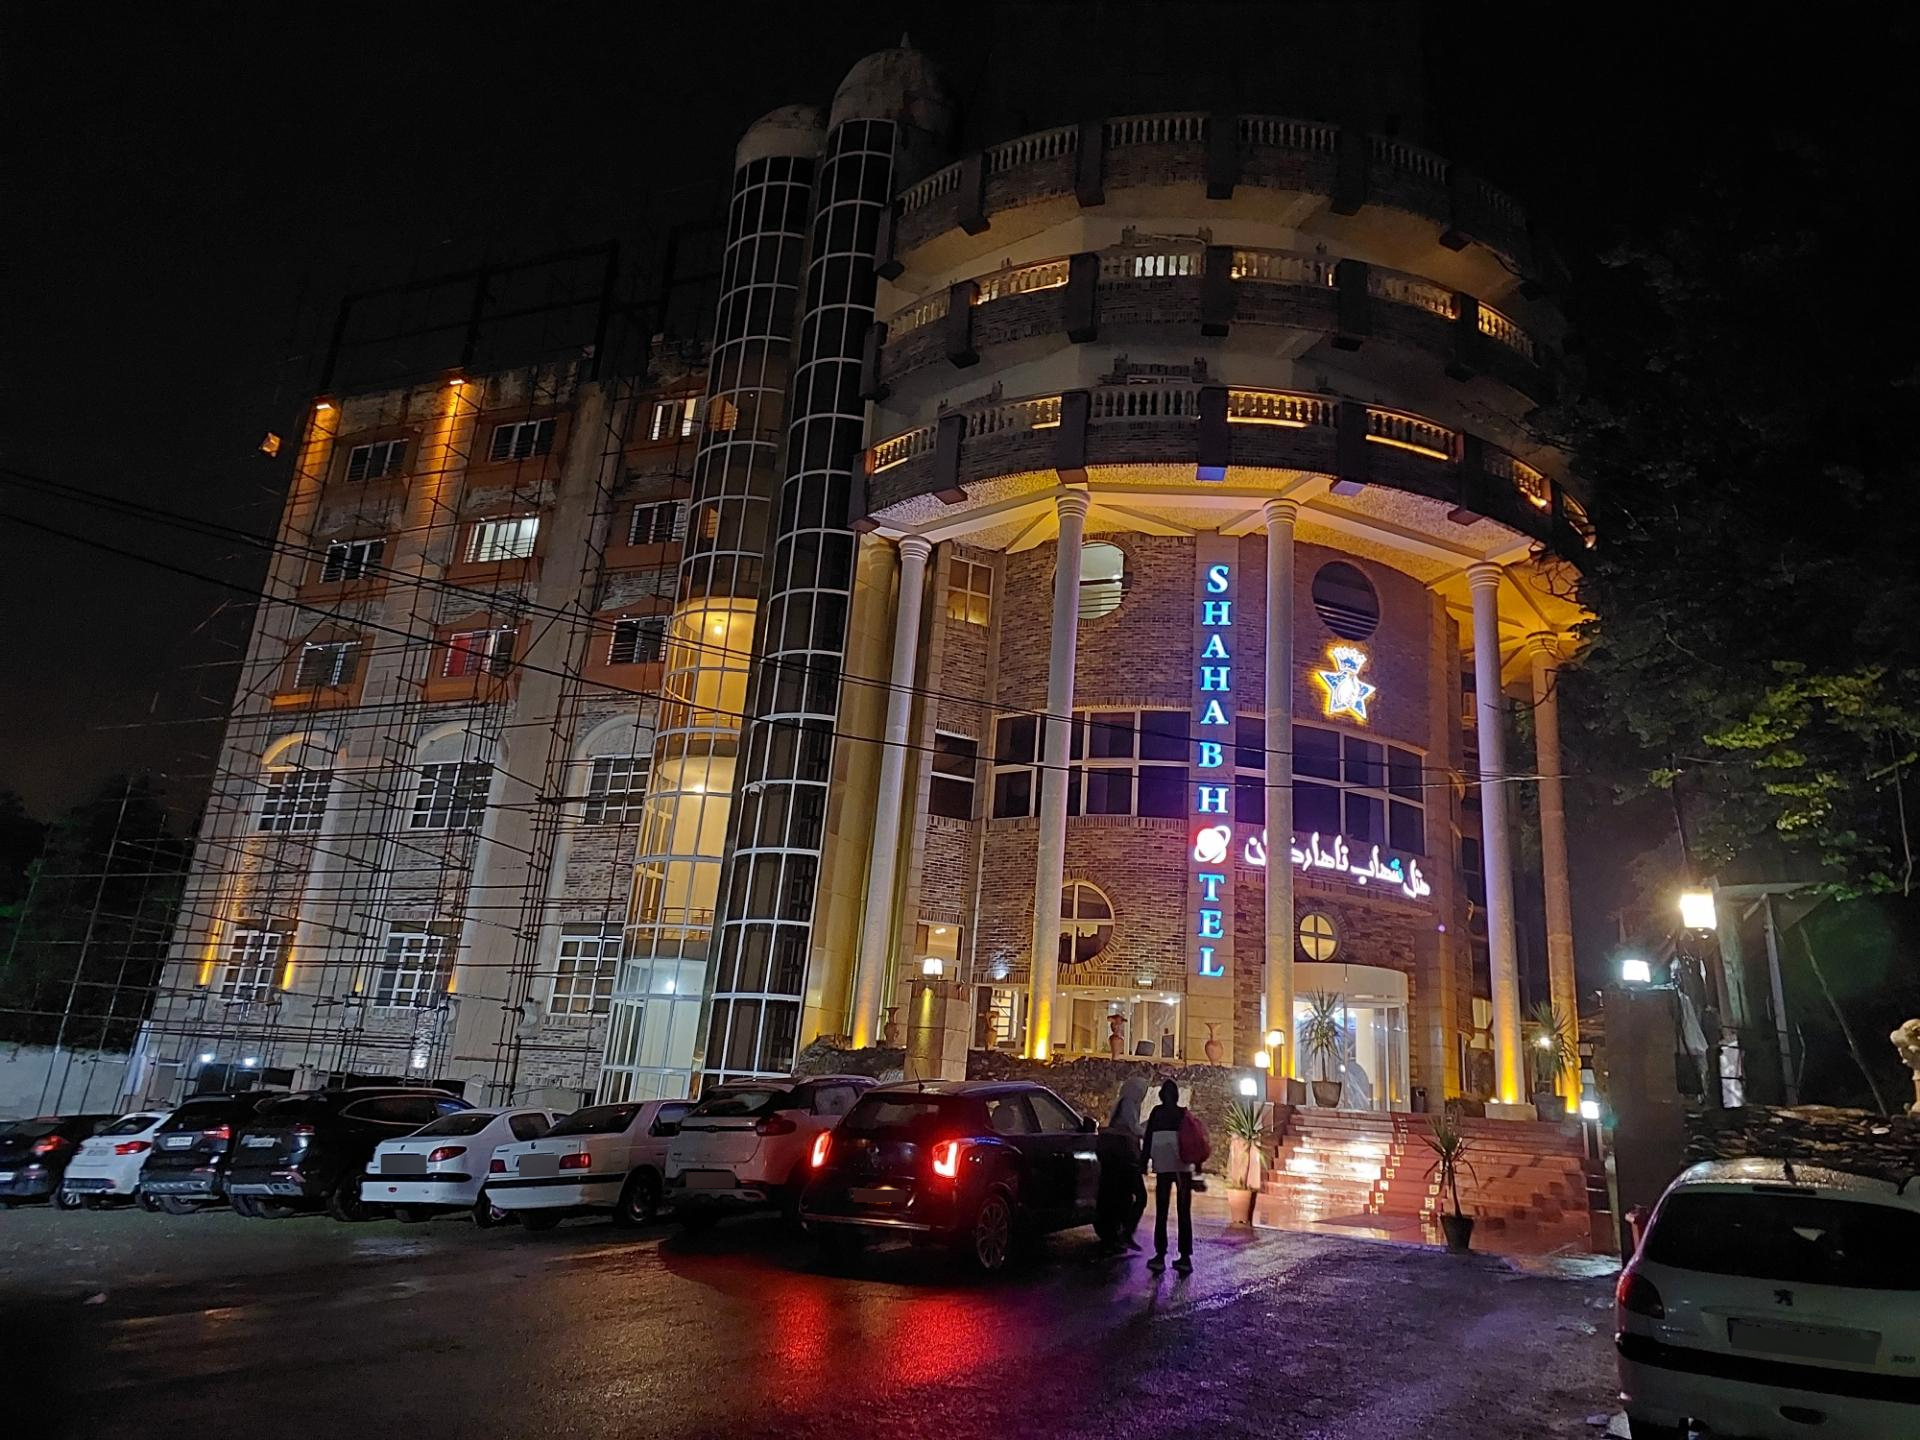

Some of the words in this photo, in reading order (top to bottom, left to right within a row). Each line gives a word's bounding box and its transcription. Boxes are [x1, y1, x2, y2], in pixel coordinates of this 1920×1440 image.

[1198, 564, 1232, 769] SHAHAB
[1244, 828, 1350, 872] ناهارخن
[1350, 844, 1404, 885] شهاب
[1402, 858, 1431, 899] هتل
